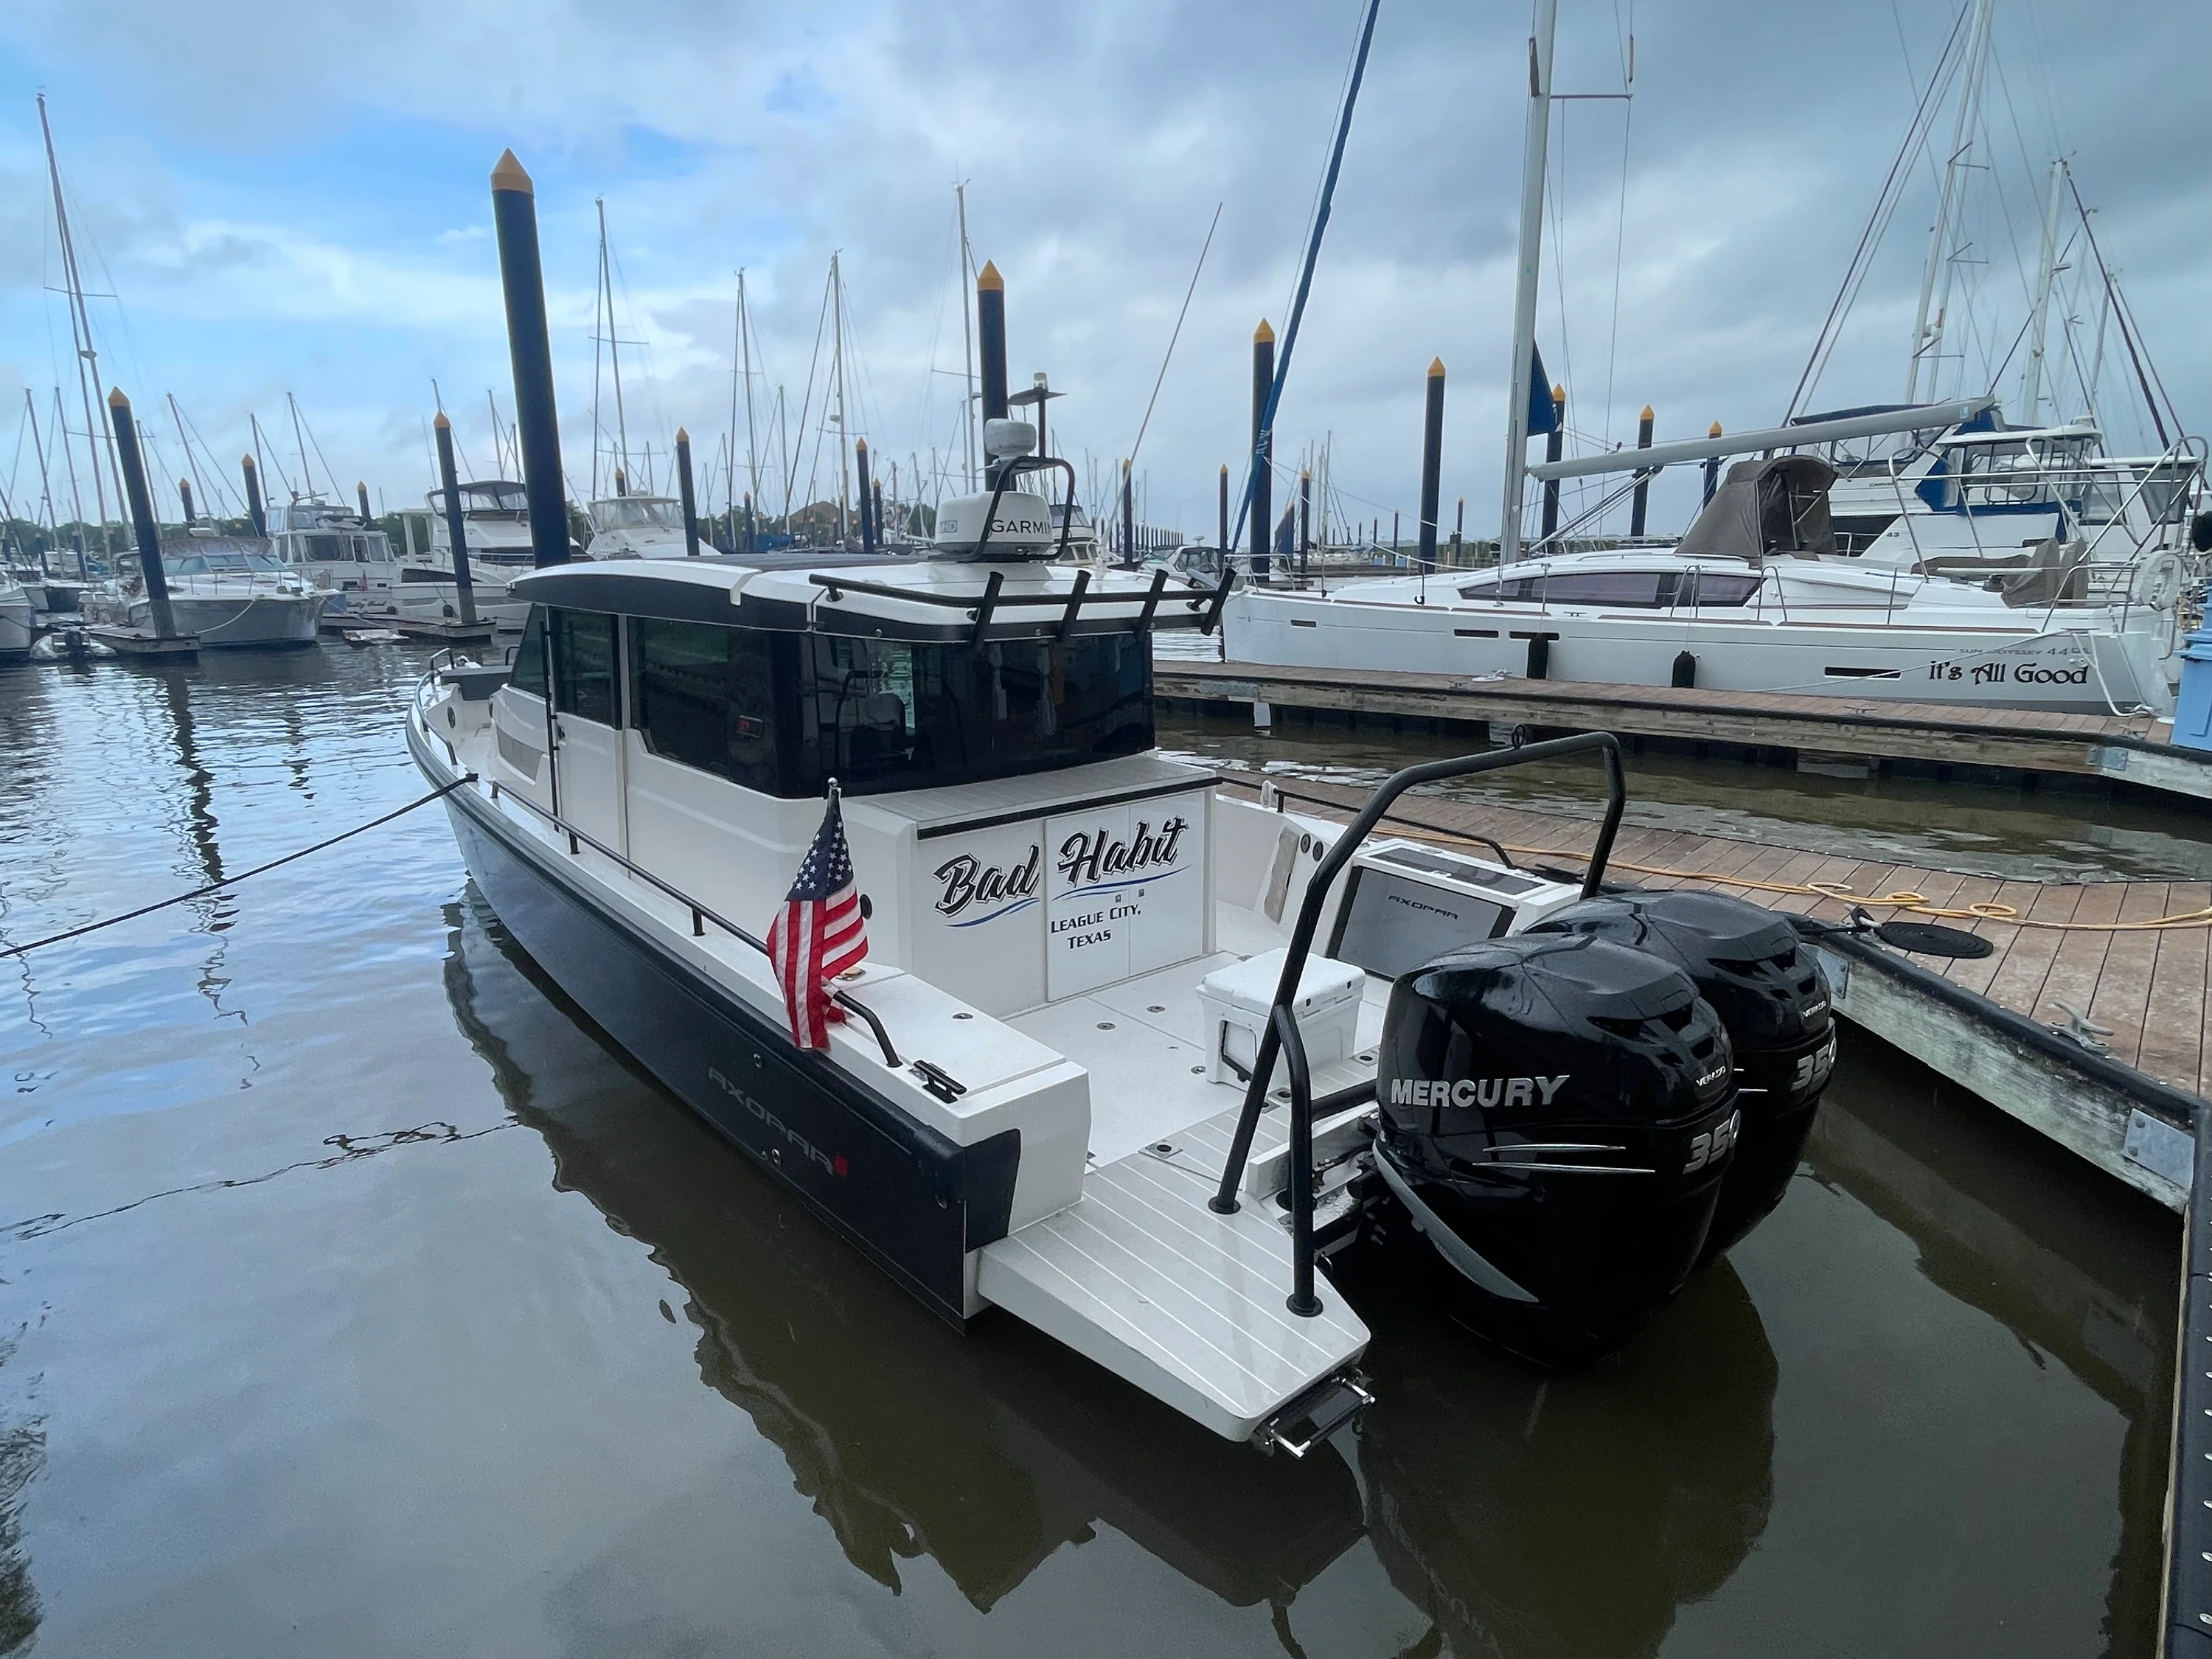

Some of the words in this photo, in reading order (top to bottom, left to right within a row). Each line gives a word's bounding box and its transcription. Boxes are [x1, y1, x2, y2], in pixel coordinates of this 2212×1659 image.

[991, 520, 1052, 535] GARMIN
[1970, 662, 2006, 686] All
[2014, 662, 2089, 684] Good
[931, 841, 1041, 918] Bad
[1057, 815, 1190, 887] Habit
[1050, 911, 1105, 935] LEAGUE
[1109, 902, 1142, 921] CITY,
[1388, 894, 1458, 920] AXOPAR
[1067, 928, 1112, 950] TEXAS
[1695, 1065, 1727, 1088] VERADO
[1790, 1037, 1837, 1092] 350
[1391, 1074, 1571, 1107] MERCURY
[707, 1067, 835, 1177] AXOPAR
[1682, 1108, 1742, 1175] 350
